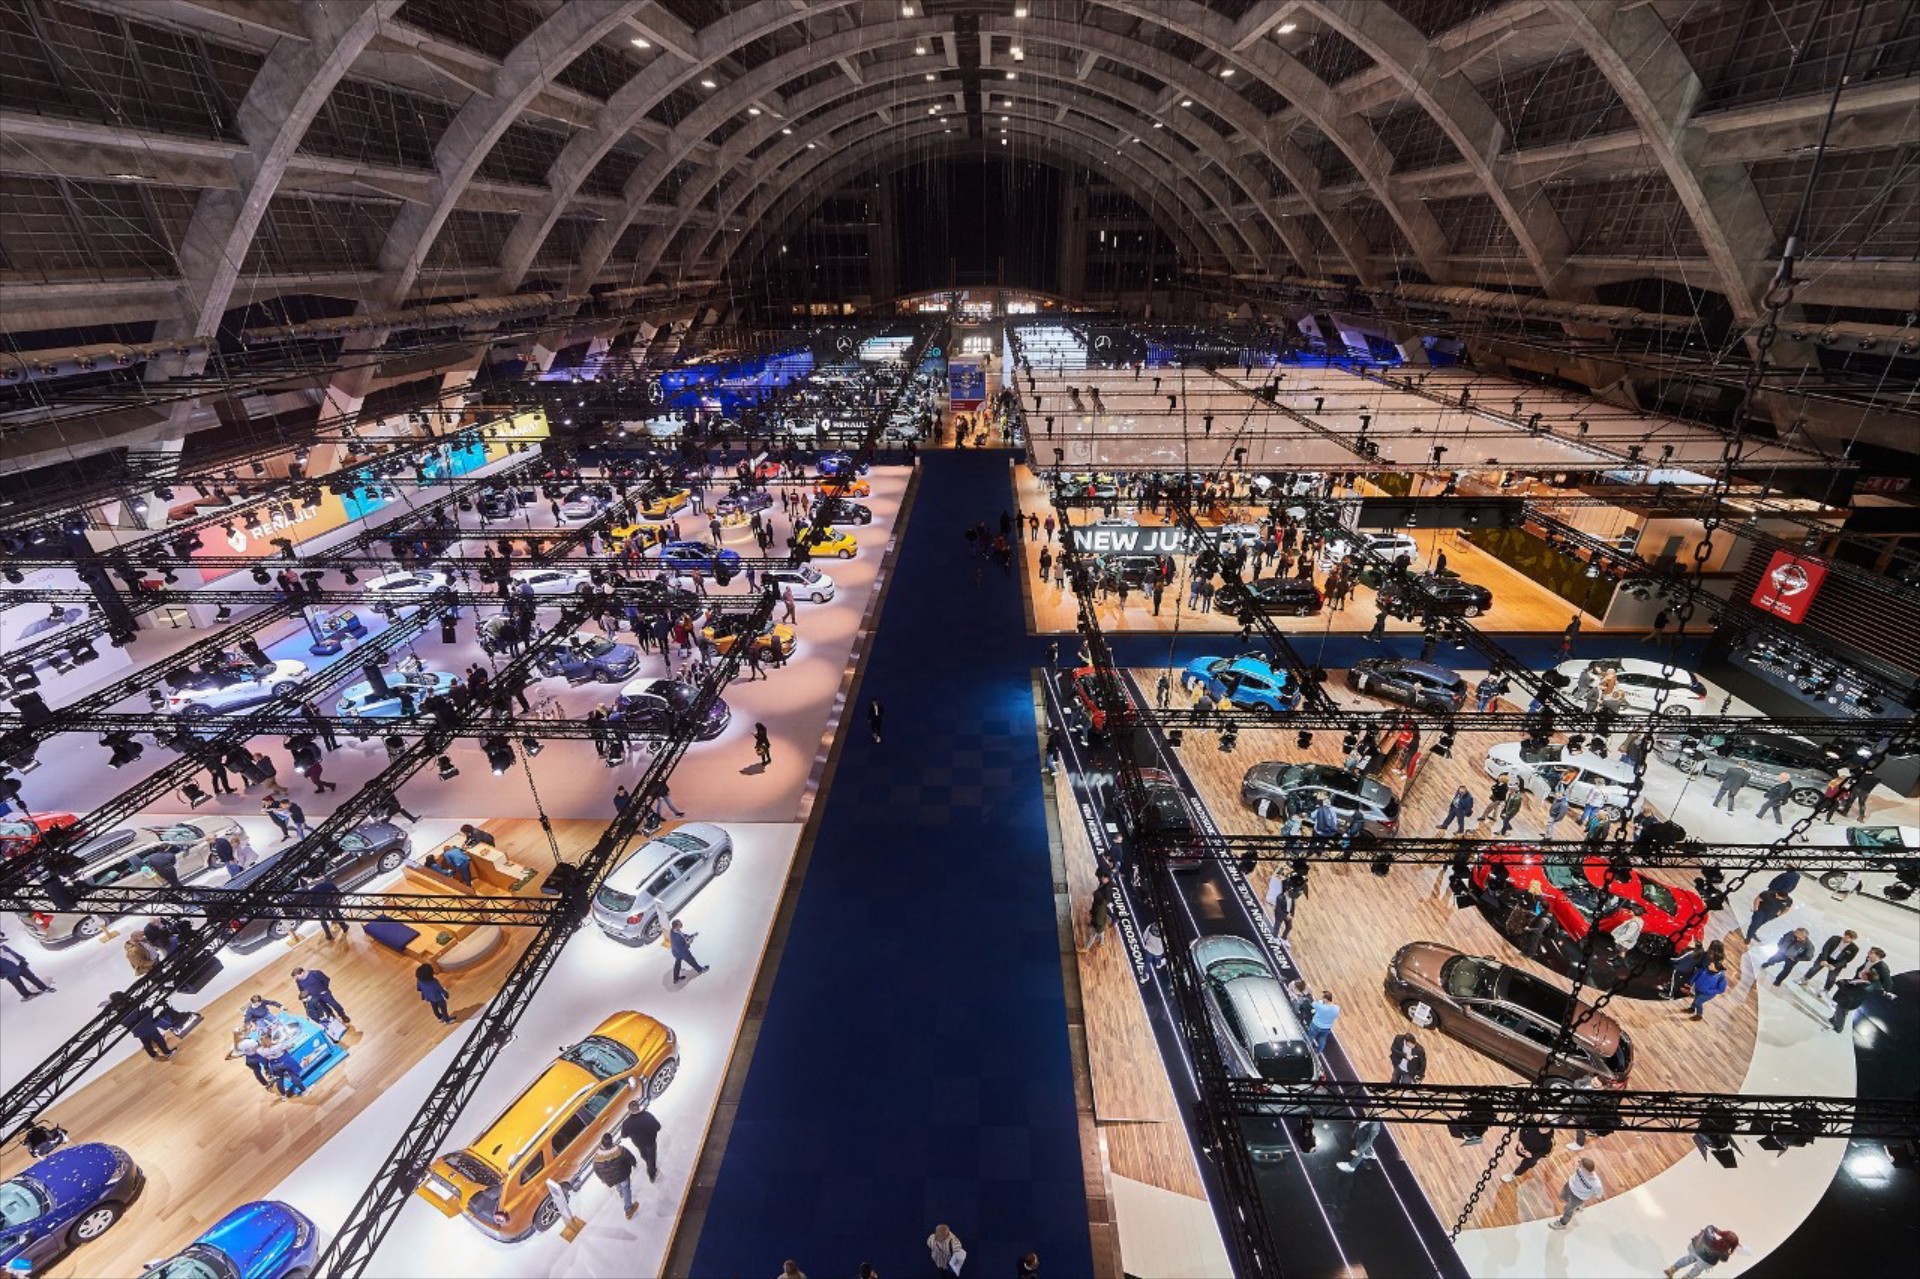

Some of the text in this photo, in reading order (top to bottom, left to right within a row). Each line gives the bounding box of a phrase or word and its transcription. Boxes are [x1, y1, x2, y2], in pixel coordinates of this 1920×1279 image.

[251, 504, 318, 540] RENAULT
[1073, 530, 1138, 551] NEW
[1227, 864, 1241, 882] THE
[1250, 907, 1277, 945] NISSAN
[1270, 943, 1291, 970] NEW
